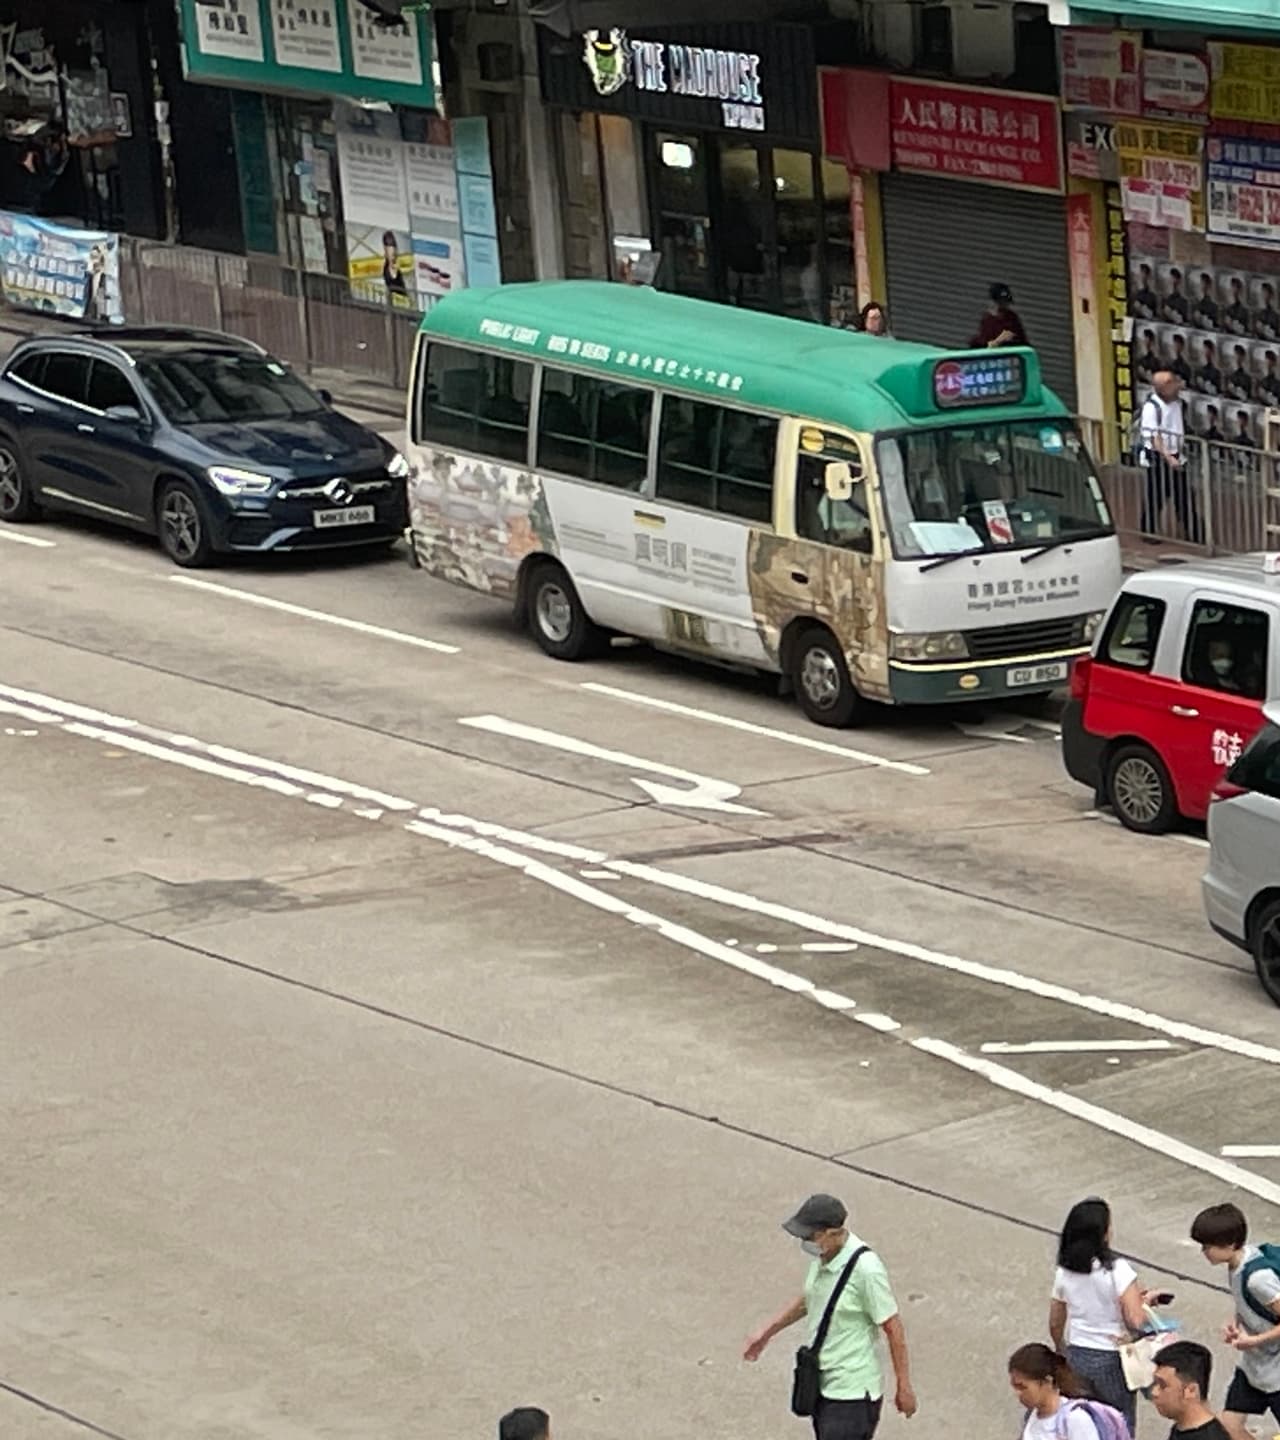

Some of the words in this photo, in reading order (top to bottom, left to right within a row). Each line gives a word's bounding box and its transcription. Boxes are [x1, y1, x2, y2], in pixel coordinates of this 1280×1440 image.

[631, 40, 667, 91] THE
[668, 45, 762, 103] MADHOUSE
[480, 319, 512, 339] PUBLIC
[512, 325, 540, 346] LIGHT
[967, 601, 991, 611] Hong
[993, 598, 1016, 608] Kong
[1213, 729, 1243, 747] 的士
